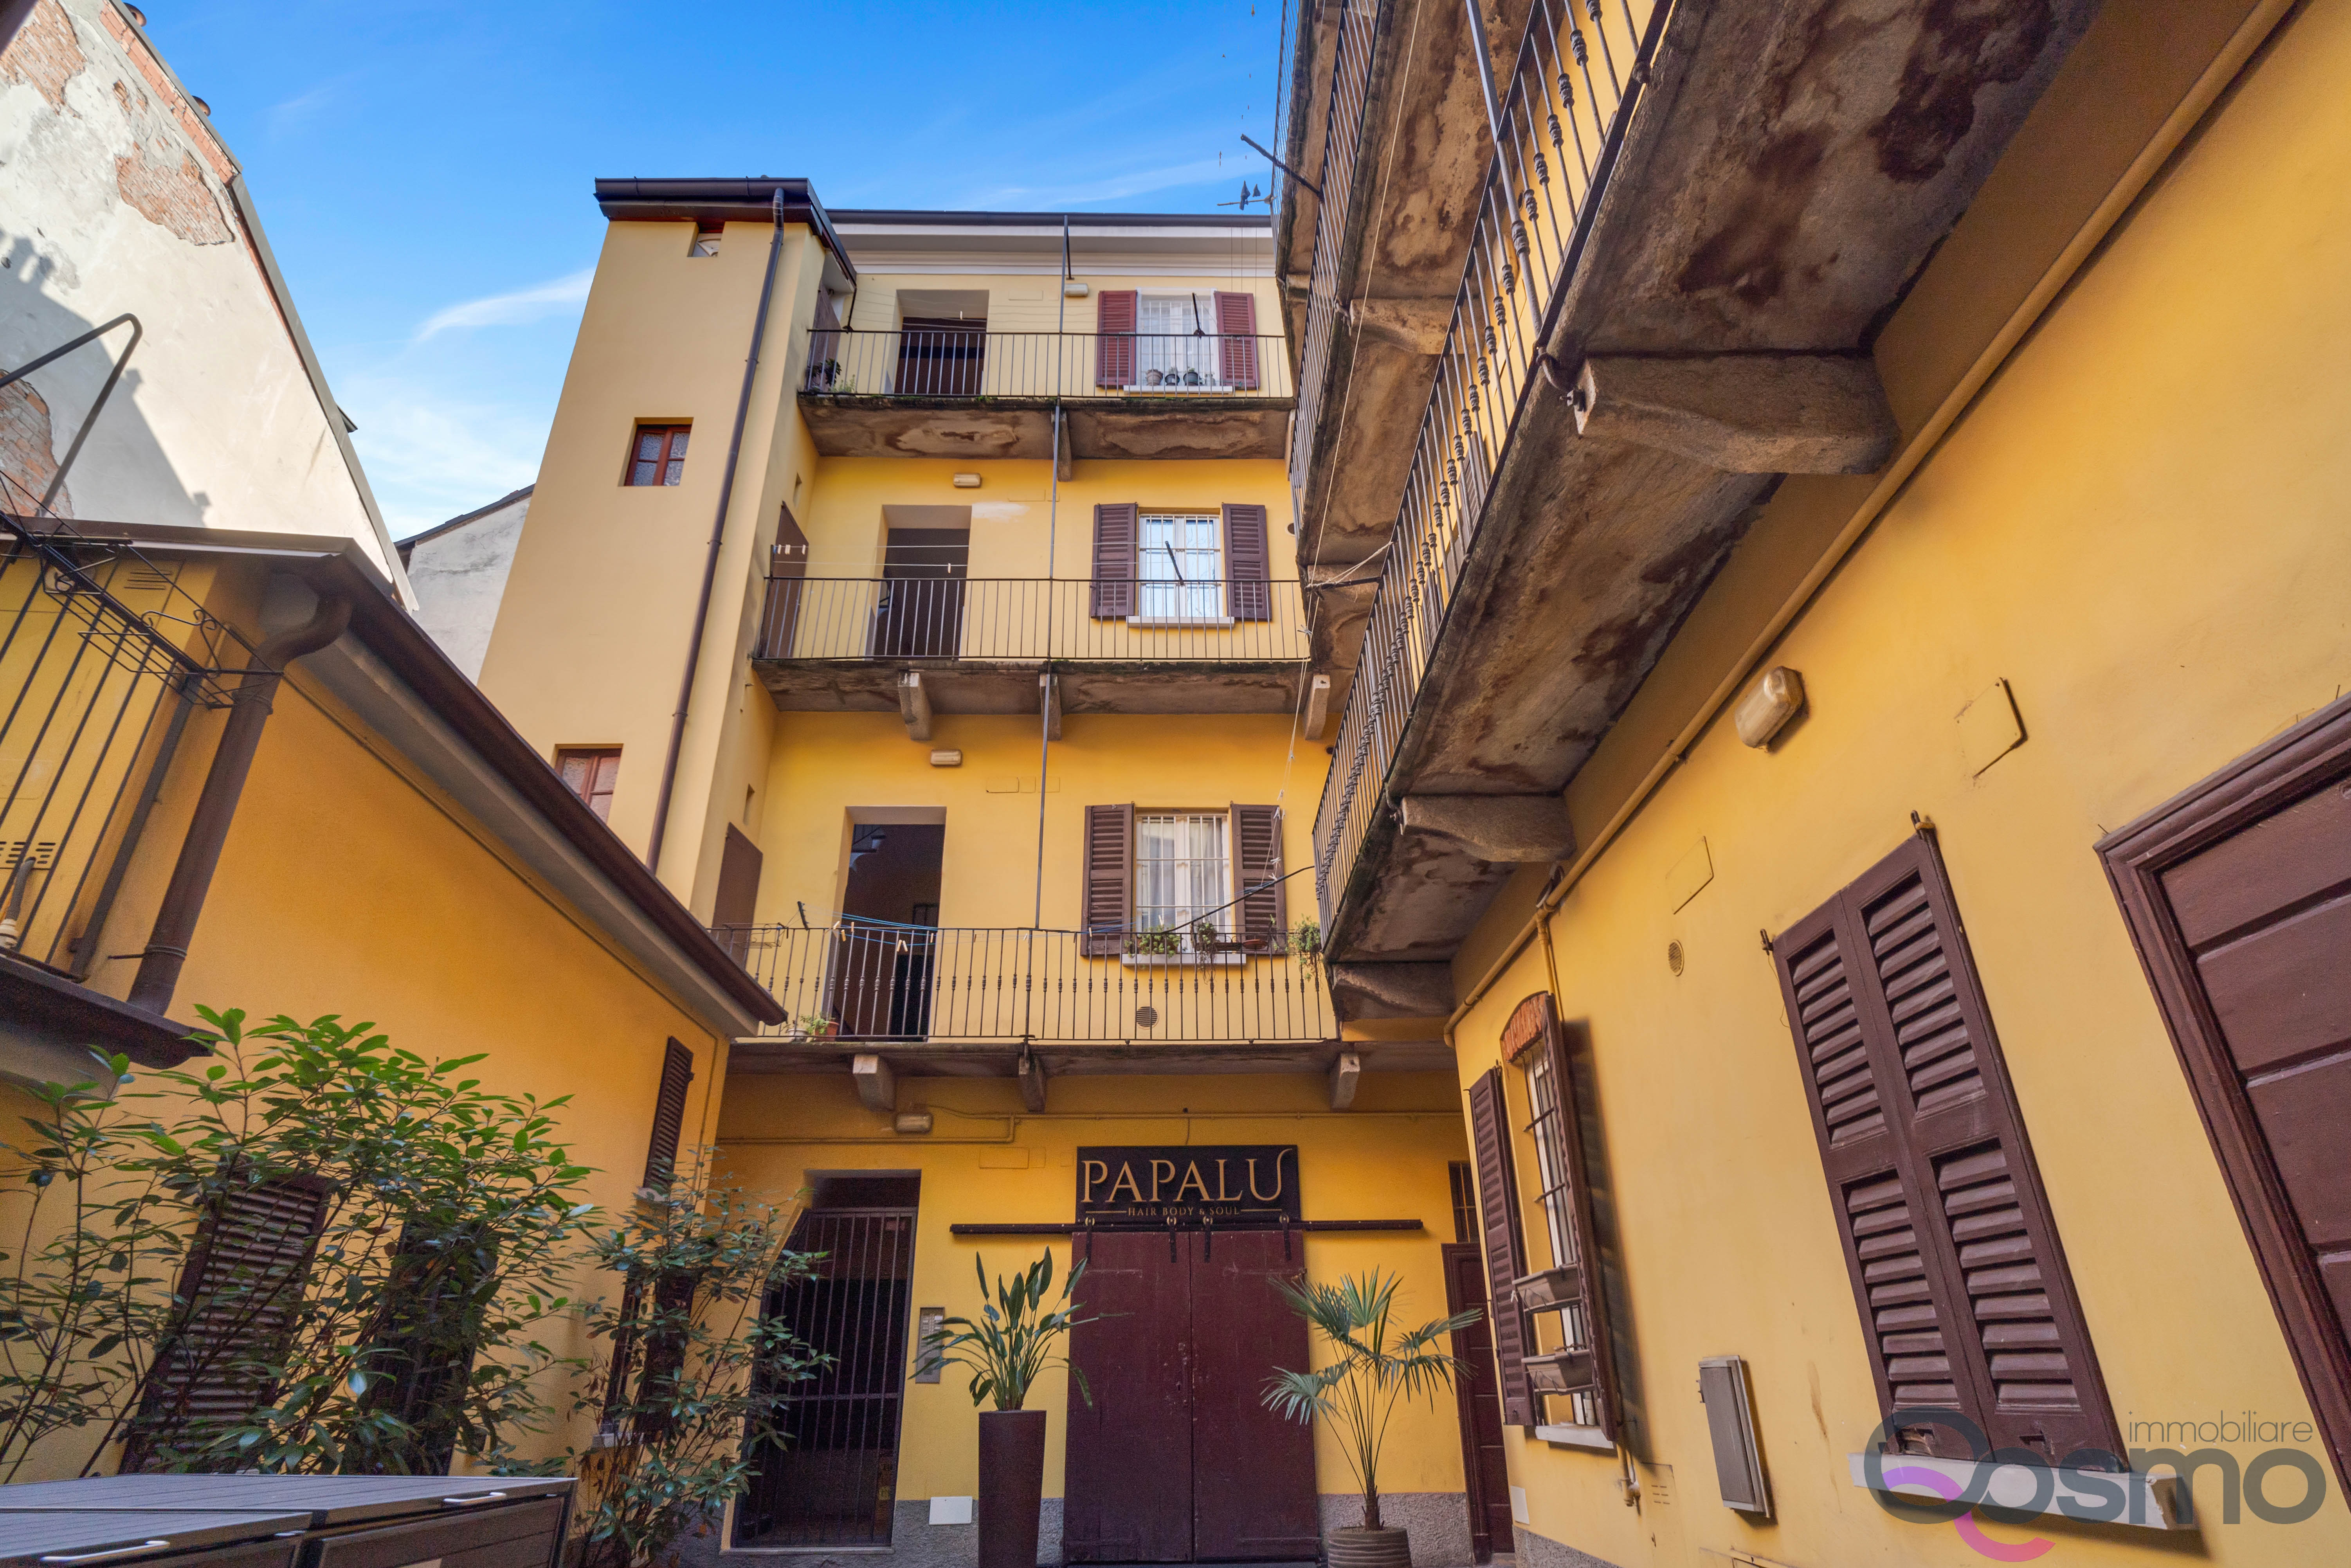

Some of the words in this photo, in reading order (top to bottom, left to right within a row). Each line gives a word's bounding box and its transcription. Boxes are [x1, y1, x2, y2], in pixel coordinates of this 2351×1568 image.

[1081, 1148, 1293, 1203] PAPALU
[1128, 1207, 1157, 1216] HAIR
[1162, 1207, 1193, 1216] BODY
[1209, 1206, 1239, 1216] SOUL
